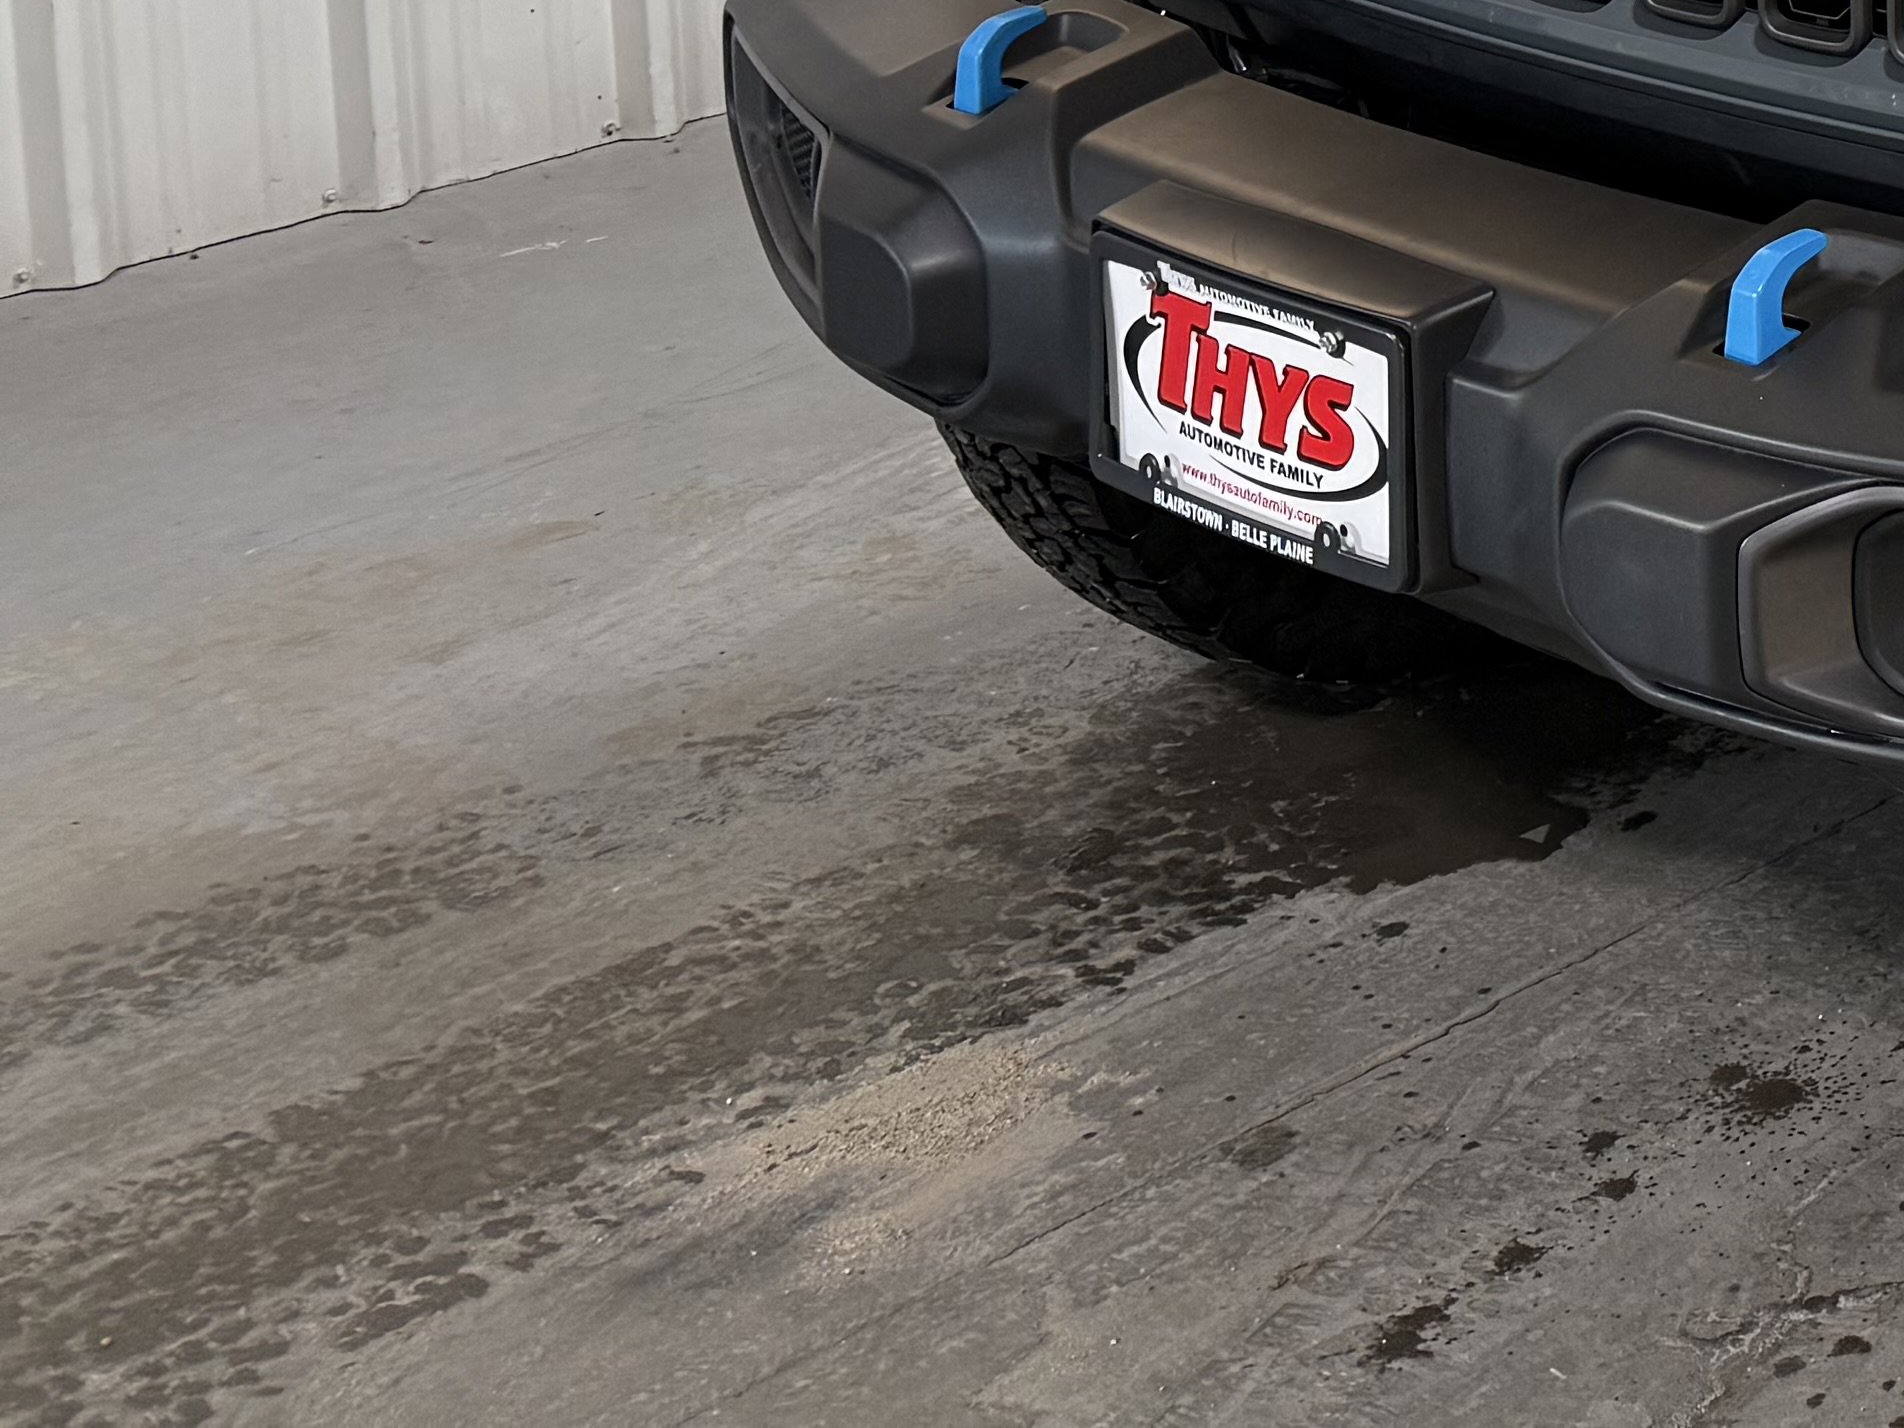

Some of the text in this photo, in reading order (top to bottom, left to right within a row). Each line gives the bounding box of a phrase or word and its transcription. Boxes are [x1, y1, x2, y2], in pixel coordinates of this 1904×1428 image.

[1149, 288, 1355, 472] THYS
[1179, 421, 1324, 489] AUTOMOTIVE FAMILY
[1153, 487, 1314, 565] BLAIRSTOWN BELLE PLAINE
